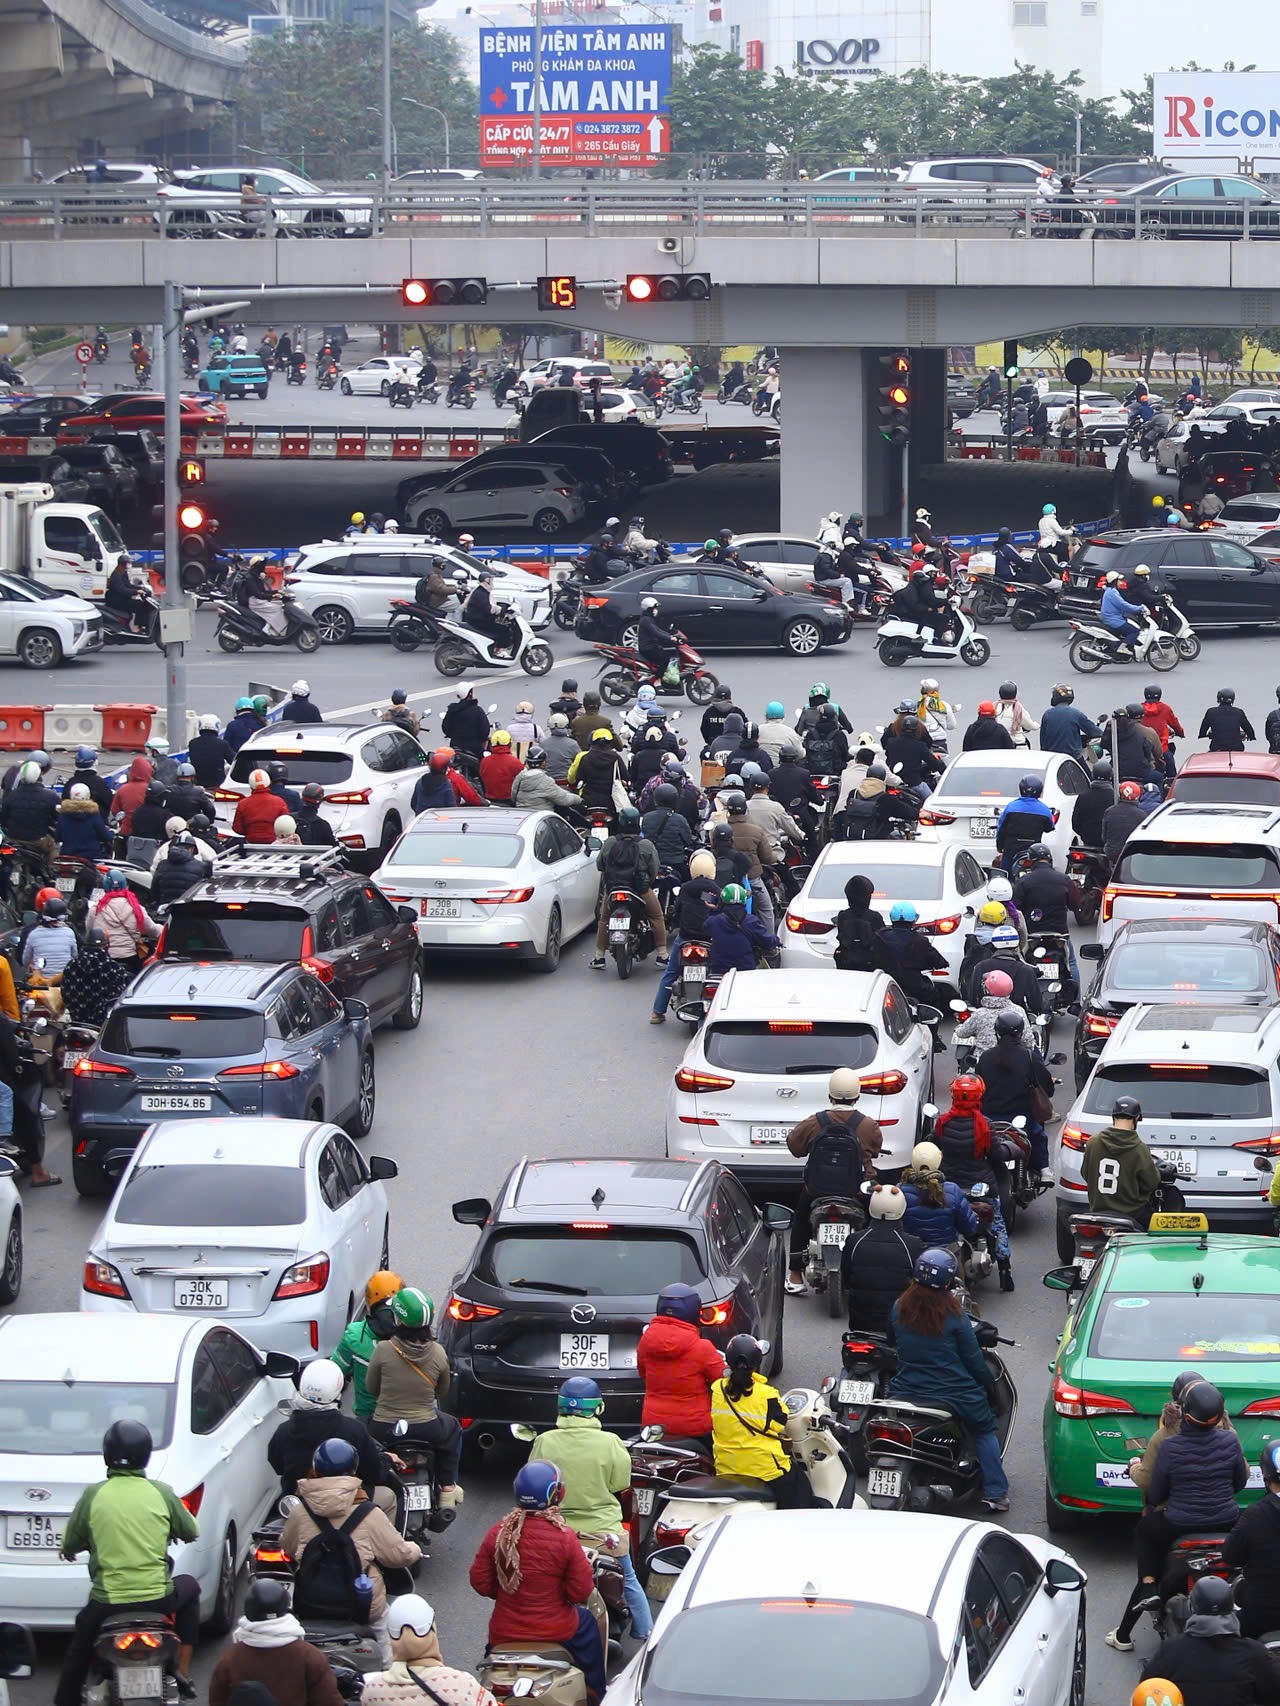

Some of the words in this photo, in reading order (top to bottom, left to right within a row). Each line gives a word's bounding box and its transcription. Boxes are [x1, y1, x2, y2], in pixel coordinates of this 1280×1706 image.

[484, 32, 531, 58] BỆNH
[583, 29, 621, 51] TÂM
[626, 32, 666, 51] ANH
[797, 39, 880, 65] LOOP
[512, 57, 549, 73] PHÒG
[552, 57, 583, 72] KHÁM
[587, 59, 602, 71] ĐA
[605, 59, 636, 72] KHOA
[511, 74, 579, 112] TÂM
[587, 80, 658, 111] ANH
[486, 124, 511, 141] CẤP
[539, 127, 570, 141] 24/7
[584, 124, 600, 134] 024
[601, 124, 620, 134] 3872
[621, 124, 640, 134] 3872
[584, 141, 600, 151] 265
[551, 278, 574, 307] 15
[147, 1098, 206, 1108] 30H-694.86
[1163, 1151, 1182, 1161] 30A
[1098, 1157, 1120, 1195] 8
[190, 1282, 213, 1294] 30K
[180, 1294, 222, 1306] 079.70
[571, 1335, 596, 1351] 30F
[561, 1352, 608, 1368] 567.95
[873, 1470, 897, 1483] 19-L6
[871, 1482, 895, 1495] 4138
[27, 1518, 53, 1531] 19A
